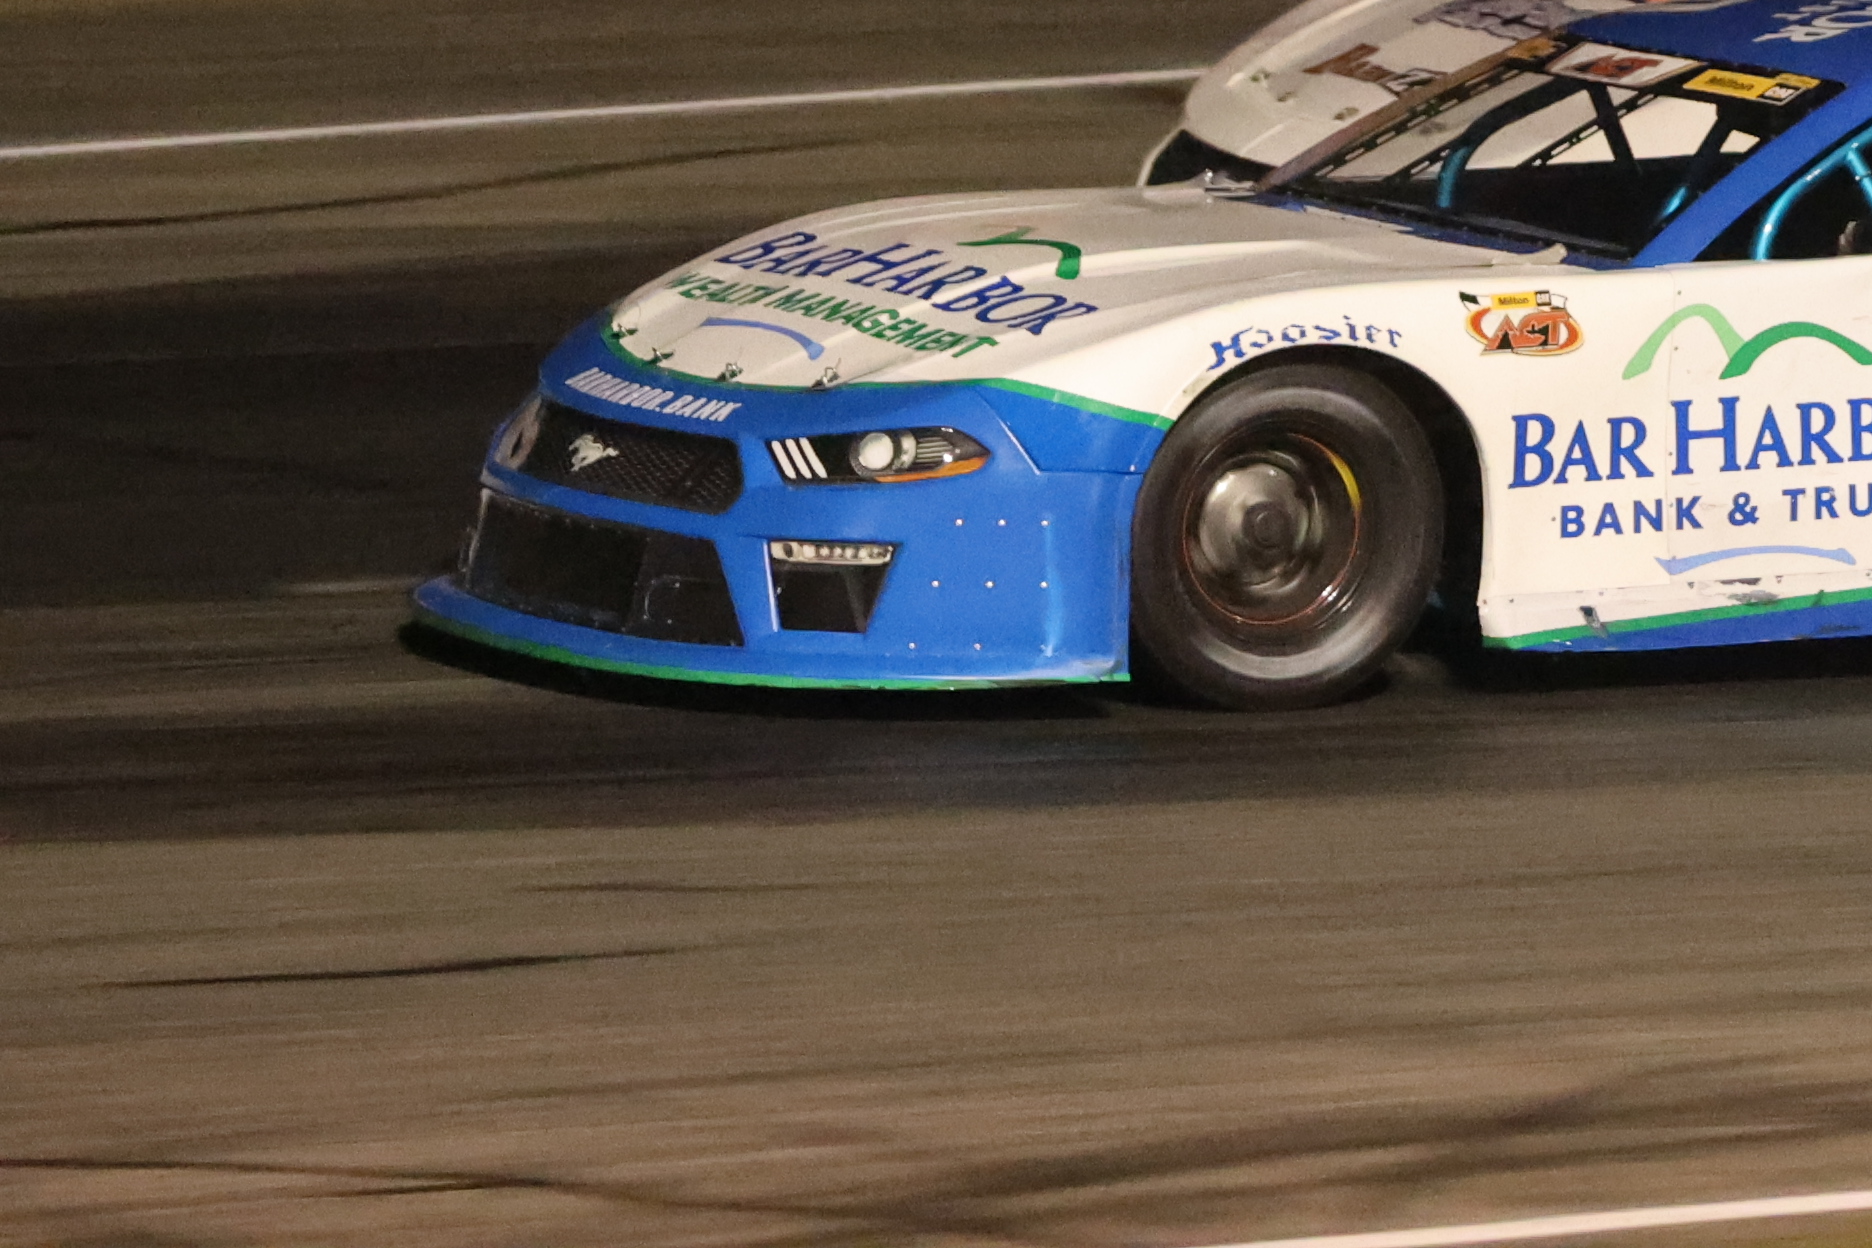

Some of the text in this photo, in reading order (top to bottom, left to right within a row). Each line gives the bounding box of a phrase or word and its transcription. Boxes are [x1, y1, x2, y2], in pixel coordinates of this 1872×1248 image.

[714, 231, 1099, 335] BAR HARBOR
[773, 287, 1000, 358] MANAGEMENT
[1206, 314, 1403, 372] Hoosier
[1508, 412, 1655, 489] BAR
[1559, 496, 1704, 539] BANK
[1727, 491, 1760, 527] &
